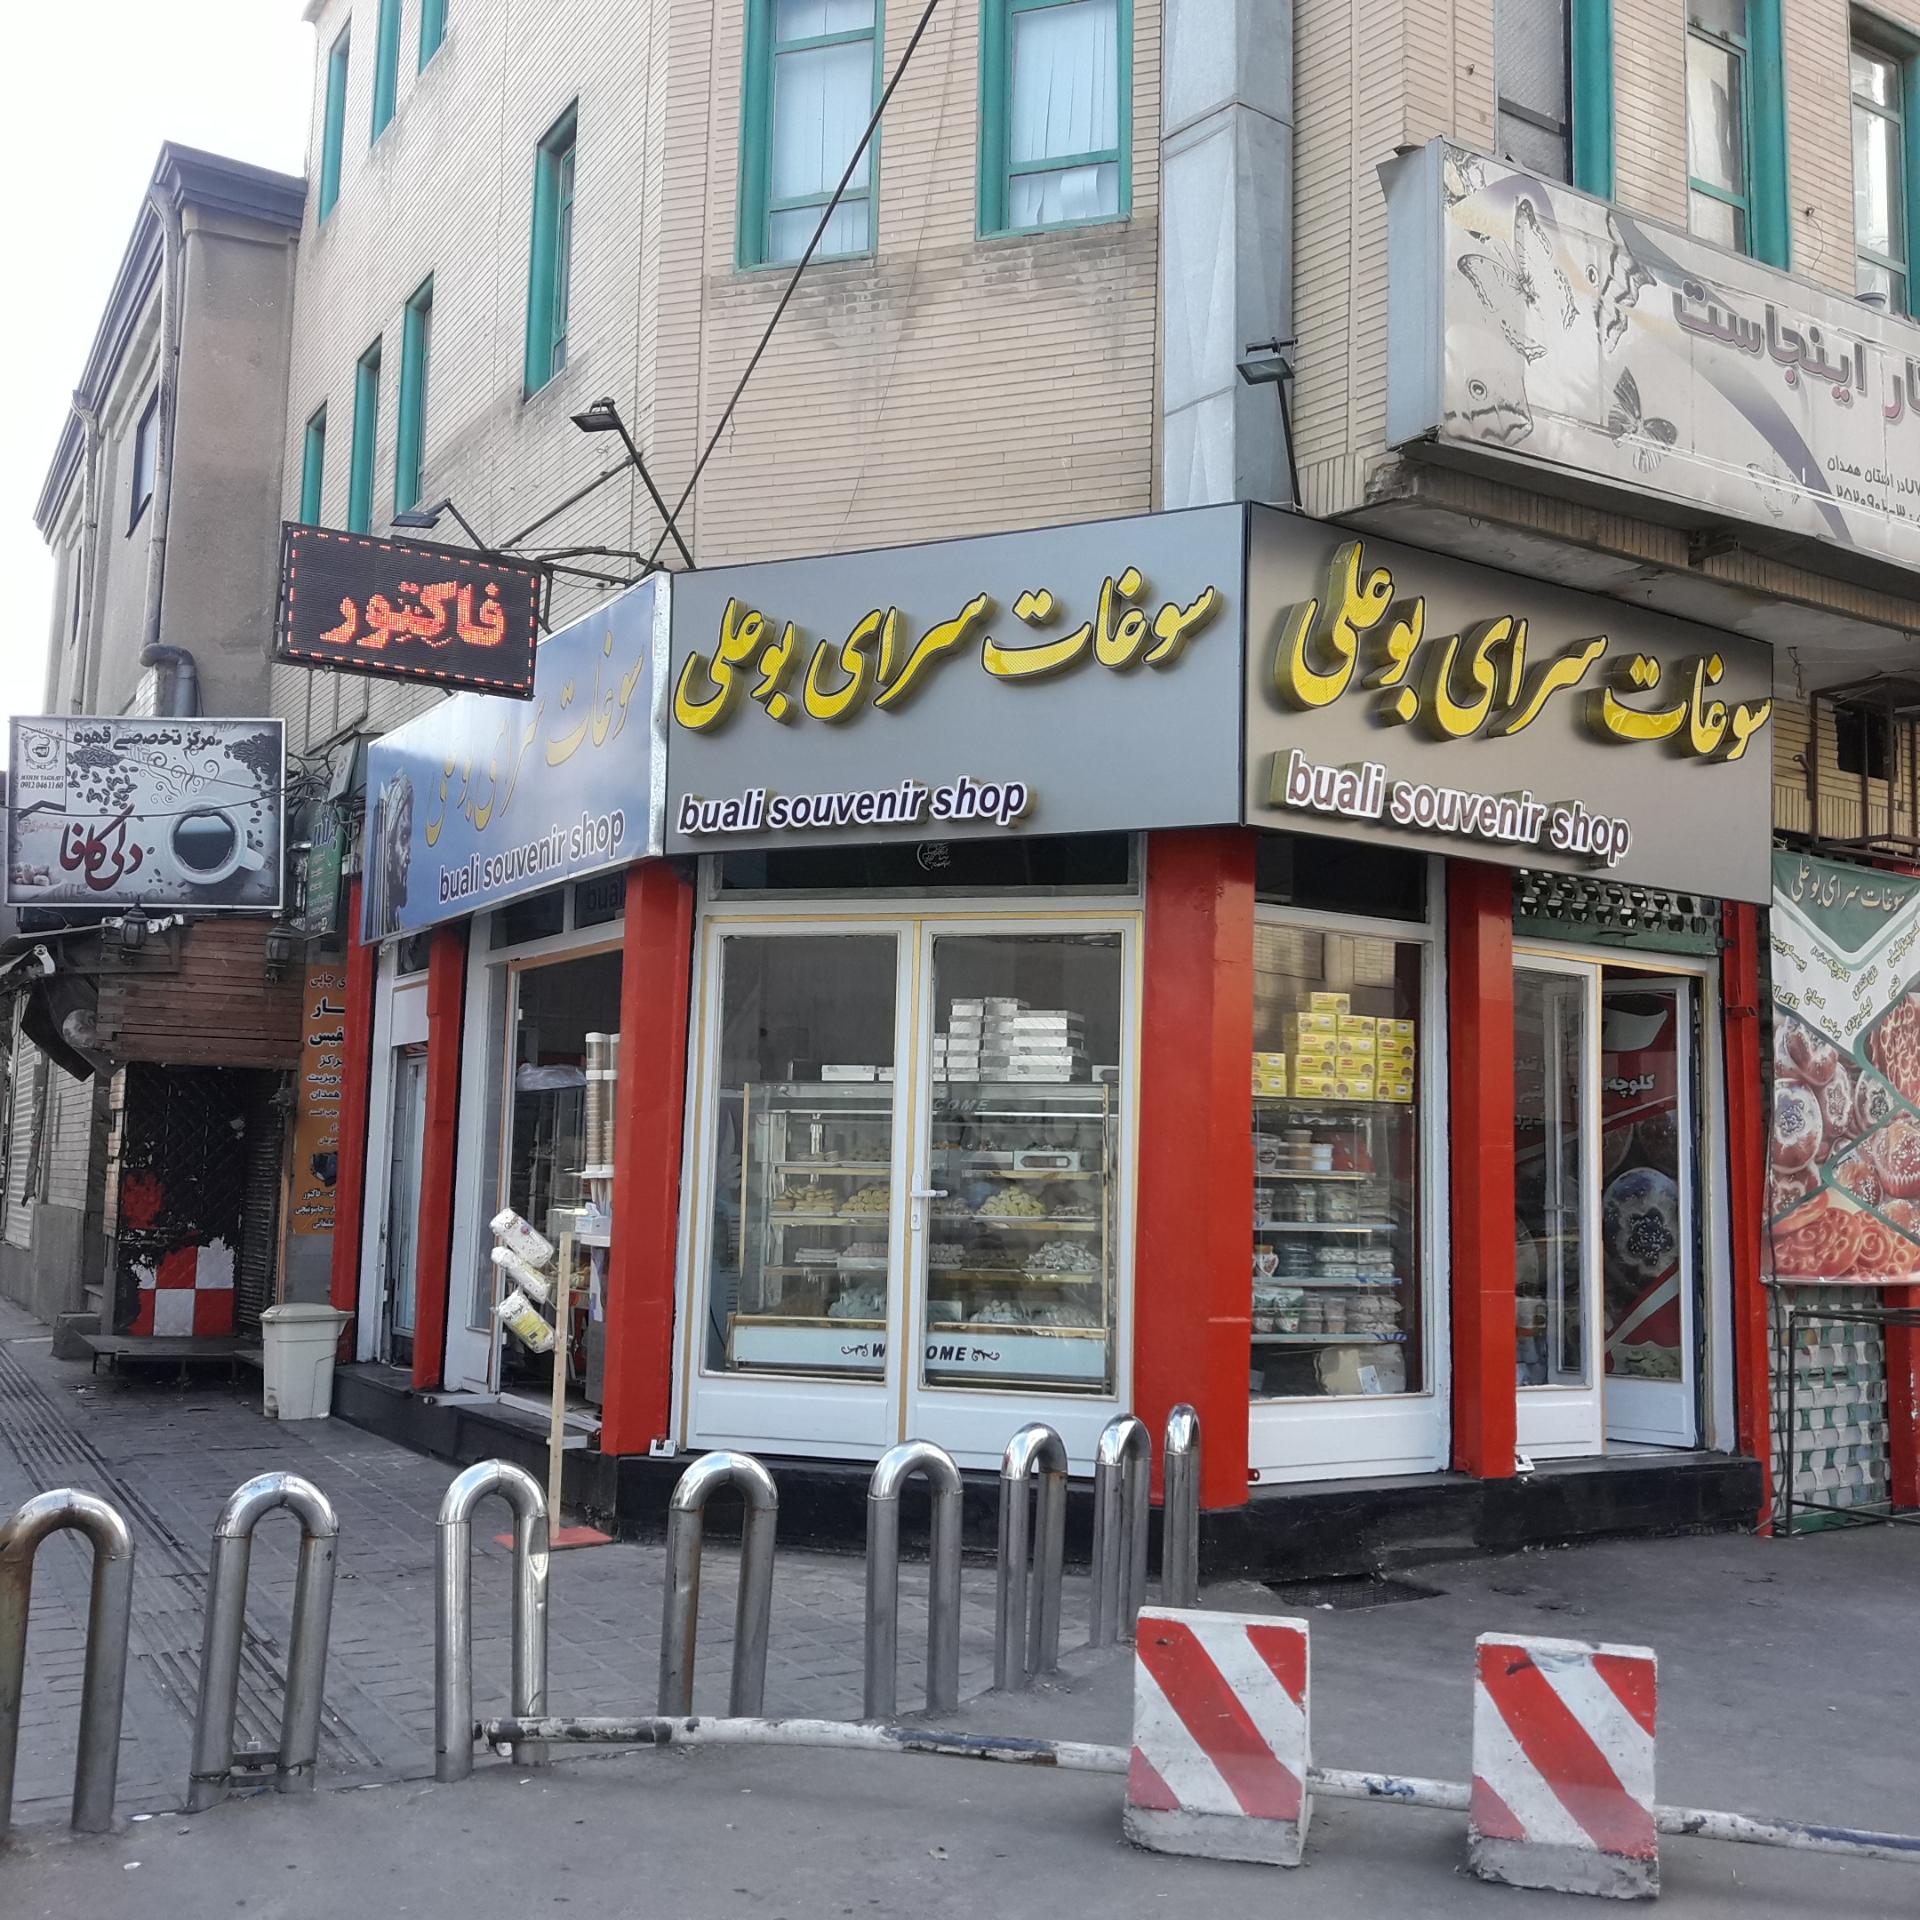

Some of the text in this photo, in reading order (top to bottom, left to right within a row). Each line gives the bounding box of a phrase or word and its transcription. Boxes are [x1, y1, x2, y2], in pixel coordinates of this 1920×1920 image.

[1671, 279, 1865, 403] اینجاست
[1827, 455, 1862, 477] همدان
[1864, 467, 1894, 488] استان
[319, 580, 504, 649] فاکتور
[982, 566, 1216, 677] سوغات
[803, 592, 988, 721] سرای
[1432, 614, 1610, 738] سرای
[546, 630, 645, 767] سوغات
[1600, 649, 1773, 762] سوغات
[73, 726, 112, 747] قهوه
[113, 728, 182, 751] تخصصی
[182, 729, 222, 751] مرکز
[474, 699, 546, 832] سرای
[676, 775, 1027, 834] buali souvenir shop
[1286, 747, 1633, 869] buali souvenir shop
[439, 807, 625, 905] buali souvenir shop
[1861, 887, 1905, 912] سوغات
[310, 1088, 341, 1100] همدان
[872, 1342, 968, 1362] WOME
